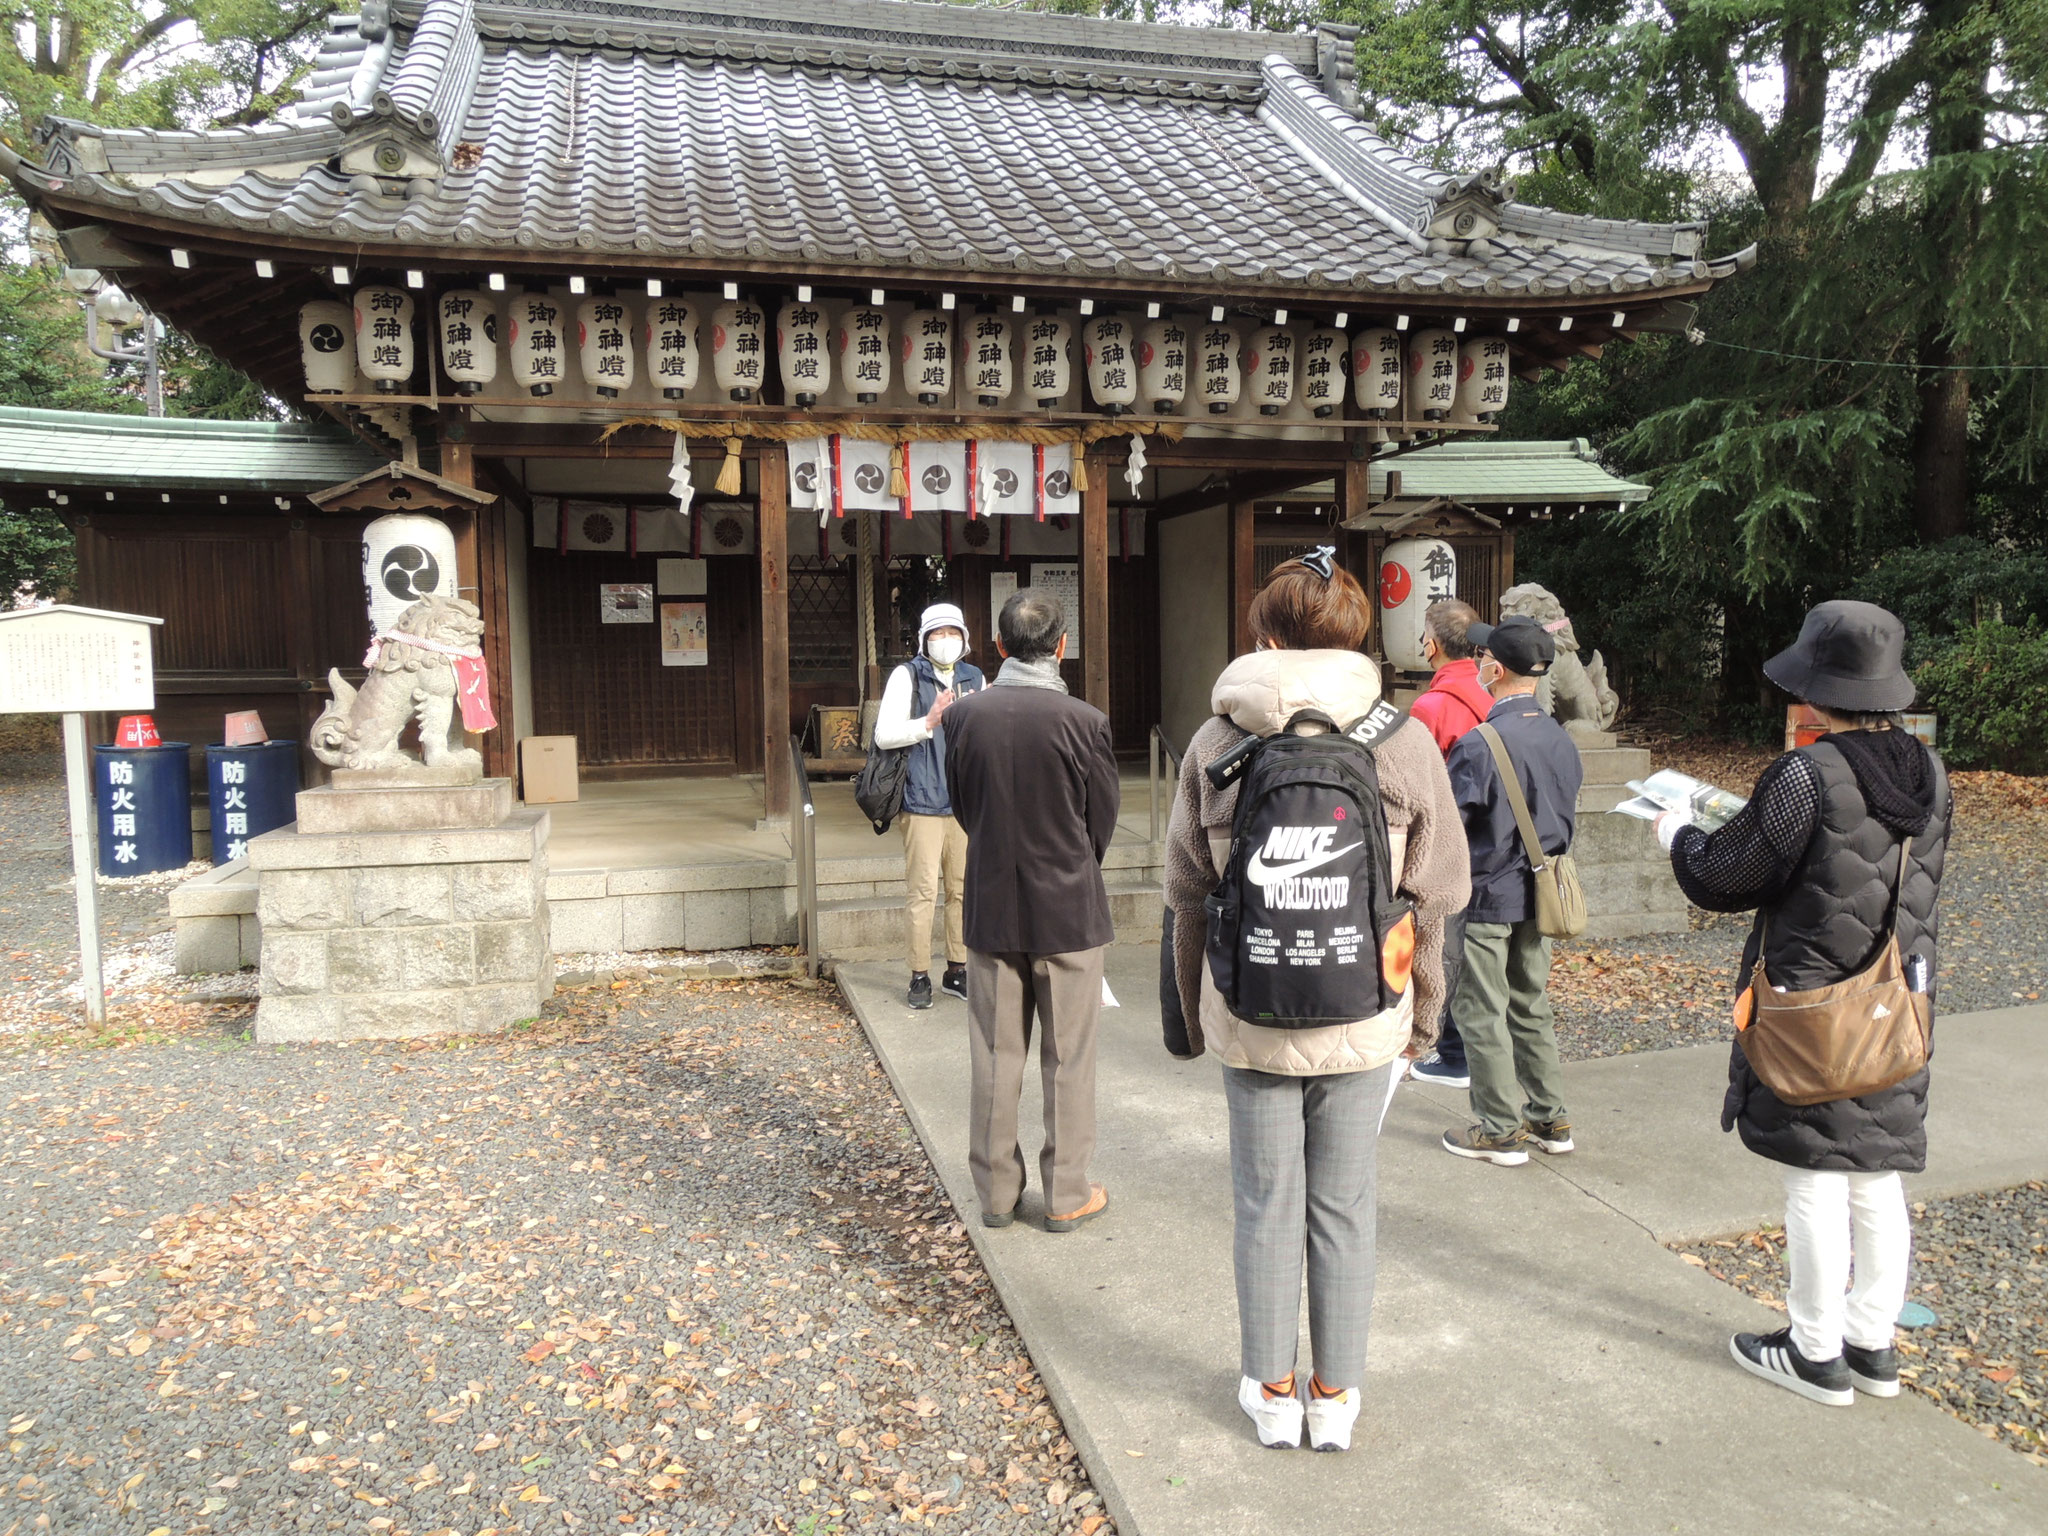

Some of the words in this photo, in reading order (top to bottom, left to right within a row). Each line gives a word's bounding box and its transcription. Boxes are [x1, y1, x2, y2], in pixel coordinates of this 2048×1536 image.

[371, 292, 403, 367] 御神燈
[444, 297, 475, 370] 御神燈
[528, 302, 558, 377] 御神燈
[594, 303, 626, 378] 御神燈
[658, 303, 688, 377] 御神燈
[734, 306, 761, 380] 御神燈
[791, 307, 820, 380] 御神燈
[855, 310, 882, 382] 御神燈
[920, 316, 947, 387] 御神燈
[976, 317, 1004, 388] 御神燈
[1032, 320, 1059, 389] 御神燈
[1096, 318, 1128, 390] 御神燈
[1162, 325, 1185, 392] 御神燈
[1204, 328, 1231, 395] 御神燈
[1265, 332, 1291, 399] 御神燈
[1307, 334, 1334, 399] 御神燈
[1379, 334, 1399, 399] 御神燈
[1429, 336, 1455, 401] 御神燈
[1481, 341, 1506, 403] 御神燈
[109, 761, 139, 864] 防火用水
[221, 760, 249, 861] 防火用水
[1261, 826, 1338, 860] NIKE
[1246, 935, 1281, 947] BARCELONA
[1248, 954, 1279, 965] SHANGHAI
[1250, 945, 1275, 956] LONDON
[1254, 927, 1273, 937] TOKYO
[1285, 948, 1297, 957] LOS
[1298, 948, 1326, 957] ANGELES
[1290, 957, 1304, 966] NEW
[1304, 957, 1322, 966] YORK
[1296, 930, 1314, 939] PARIS
[1296, 939, 1315, 948] MILAN
[1328, 936, 1351, 946] MEXICO
[1351, 934, 1364, 944] CITY
[1334, 926, 1357, 936] BEIJING
[1336, 945, 1358, 955] BERLIN
[1338, 954, 1358, 964] SEOUL
